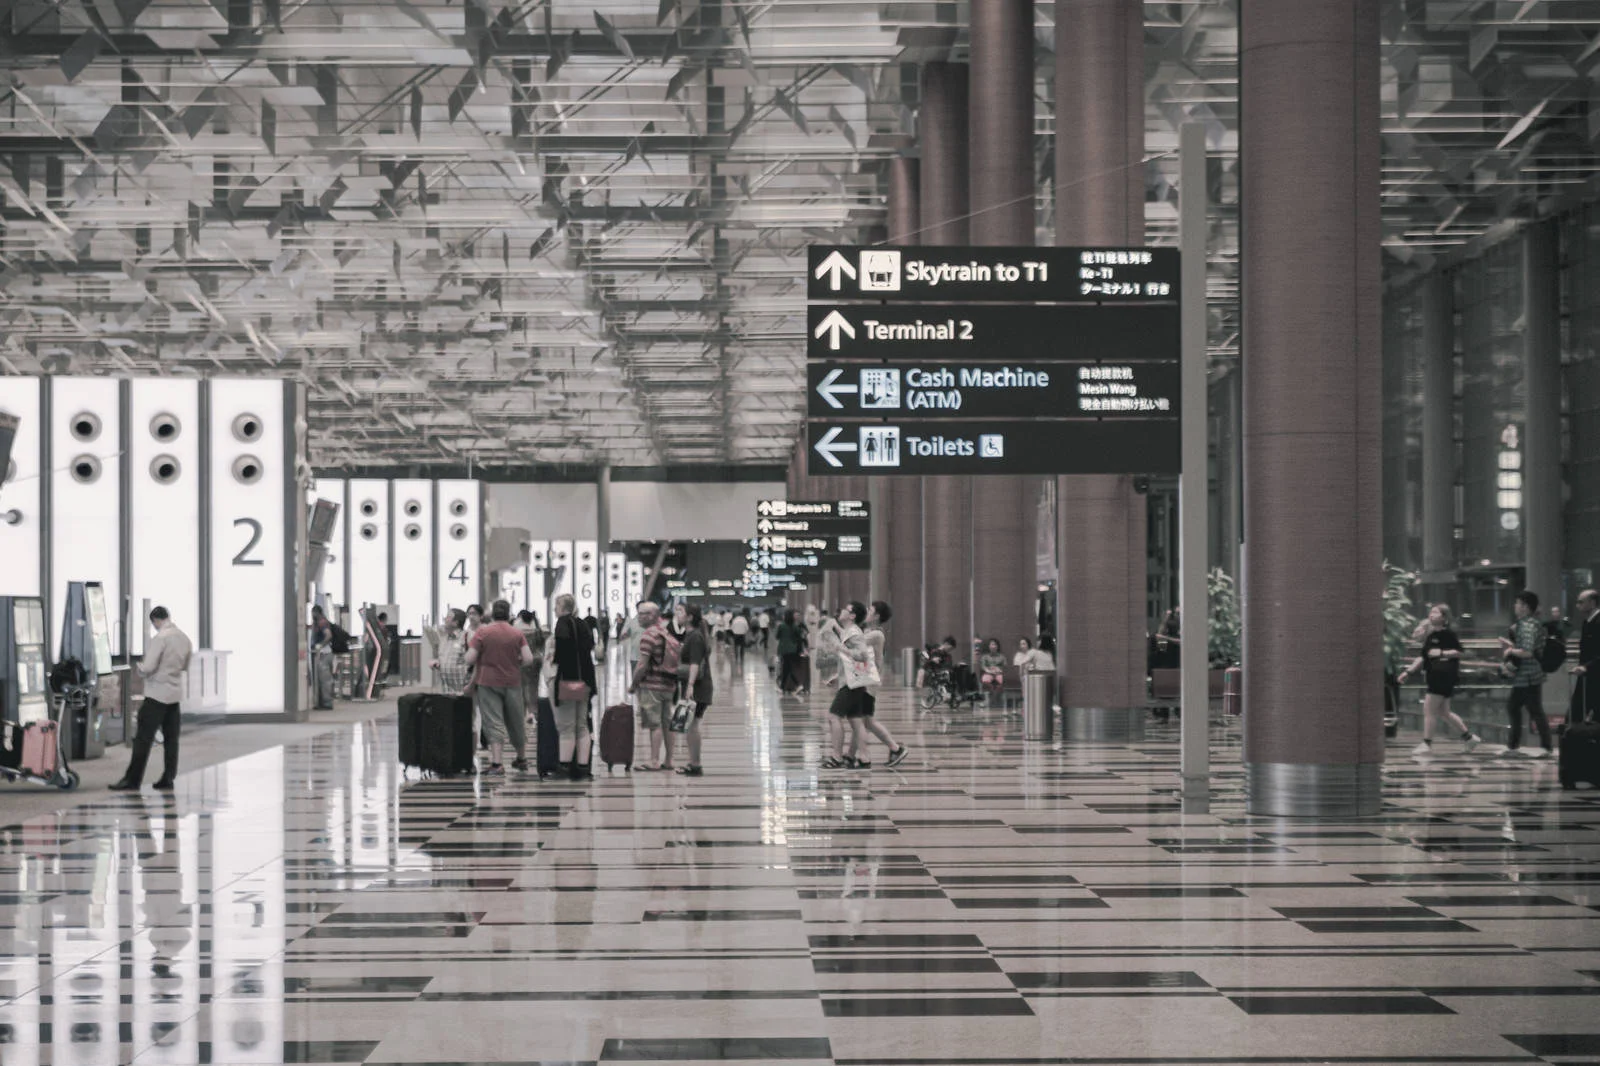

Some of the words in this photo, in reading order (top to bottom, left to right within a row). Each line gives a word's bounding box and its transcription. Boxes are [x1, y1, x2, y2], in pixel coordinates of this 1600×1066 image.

[906, 260, 991, 287] Skytrain
[994, 262, 1020, 283] to
[1023, 261, 1049, 282] T1
[863, 319, 955, 340] Terminal
[959, 320, 974, 340] 2
[906, 368, 956, 389] Cash
[960, 367, 1049, 388] Machine
[906, 389, 962, 411] (ATM)
[1079, 382, 1109, 395] Mesin
[1109, 383, 1137, 397] Wang
[906, 436, 975, 457] Toilets
[231, 517, 265, 566] 2
[448, 558, 470, 586] 4
[581, 583, 592, 600] 6
[611, 588, 620, 602] 8
